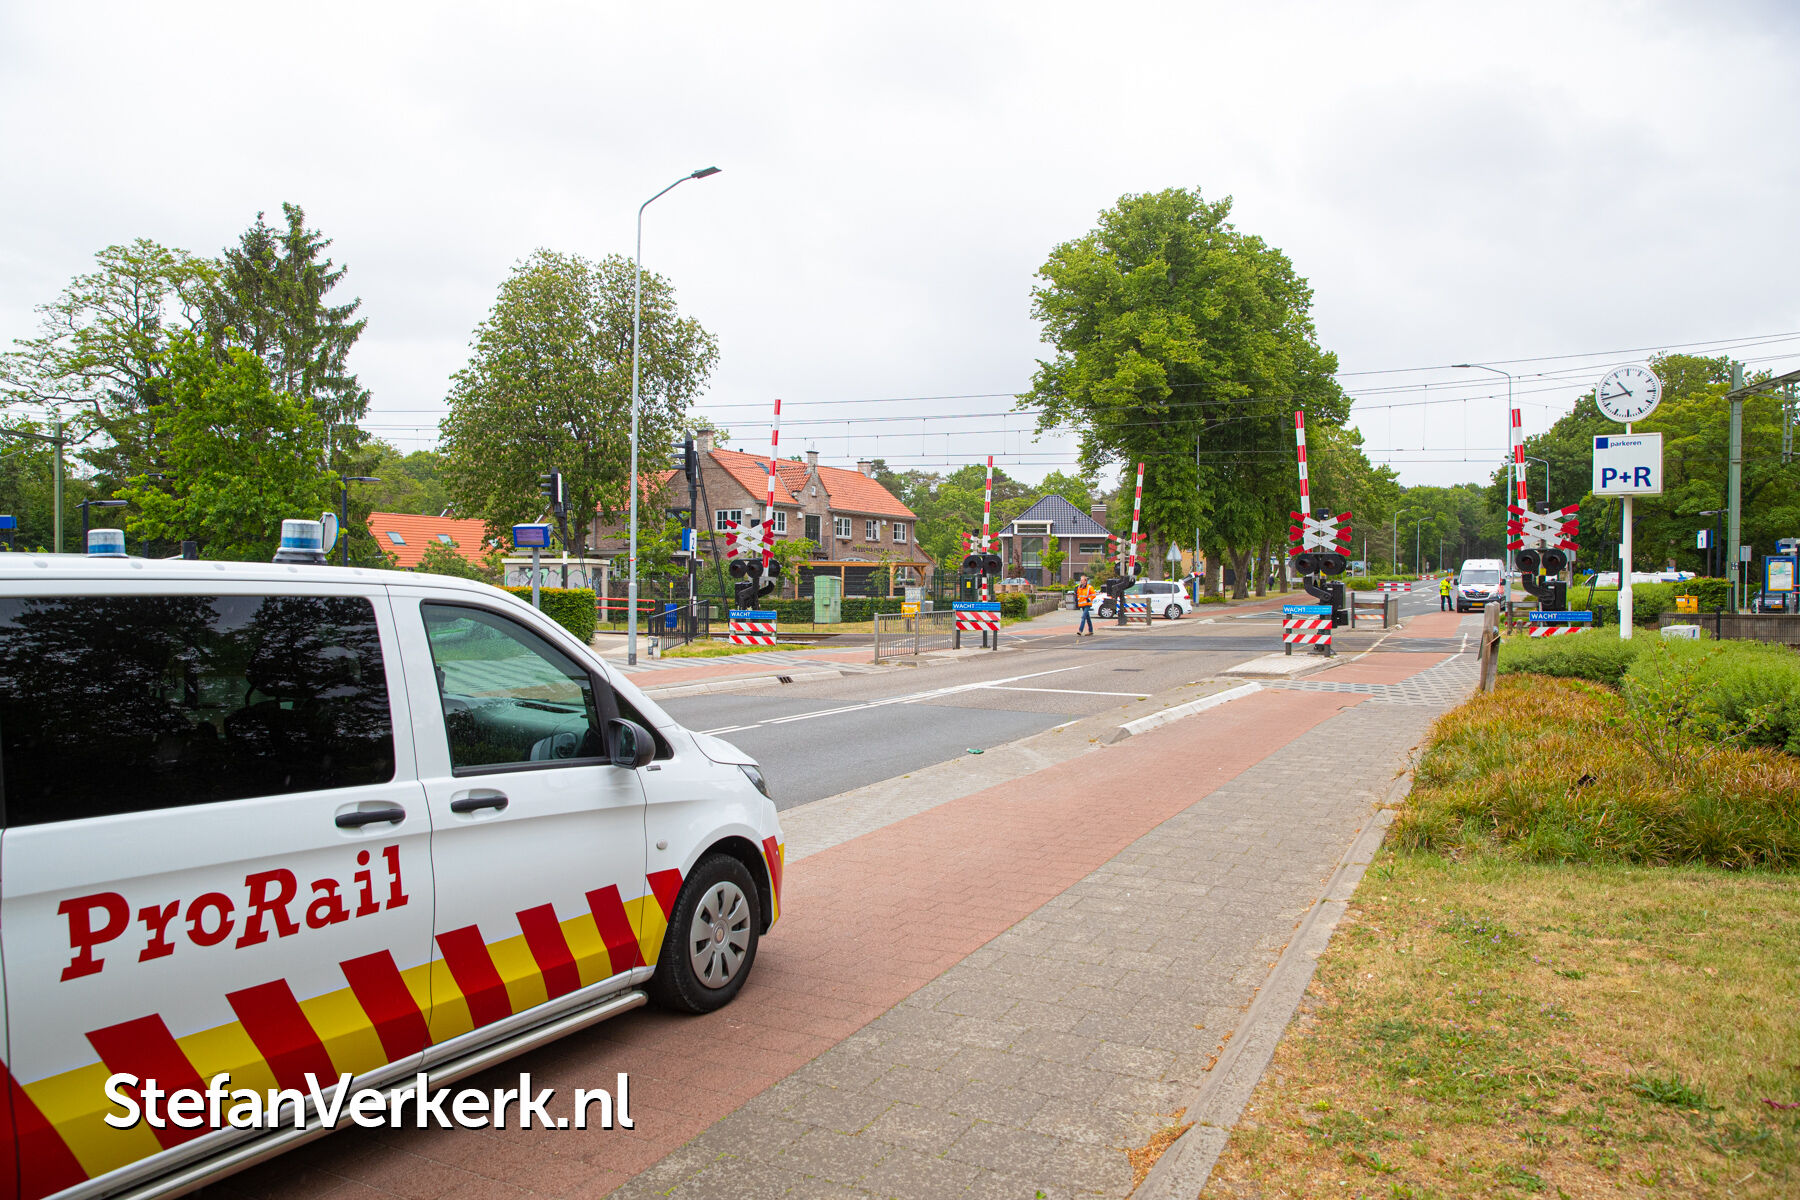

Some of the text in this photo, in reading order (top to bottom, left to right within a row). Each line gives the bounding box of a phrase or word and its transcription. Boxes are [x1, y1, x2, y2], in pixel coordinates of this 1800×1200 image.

[1610, 440, 1642, 448] parkeren
[1601, 466, 1652, 488] P+R
[57, 844, 409, 983] ProRail
